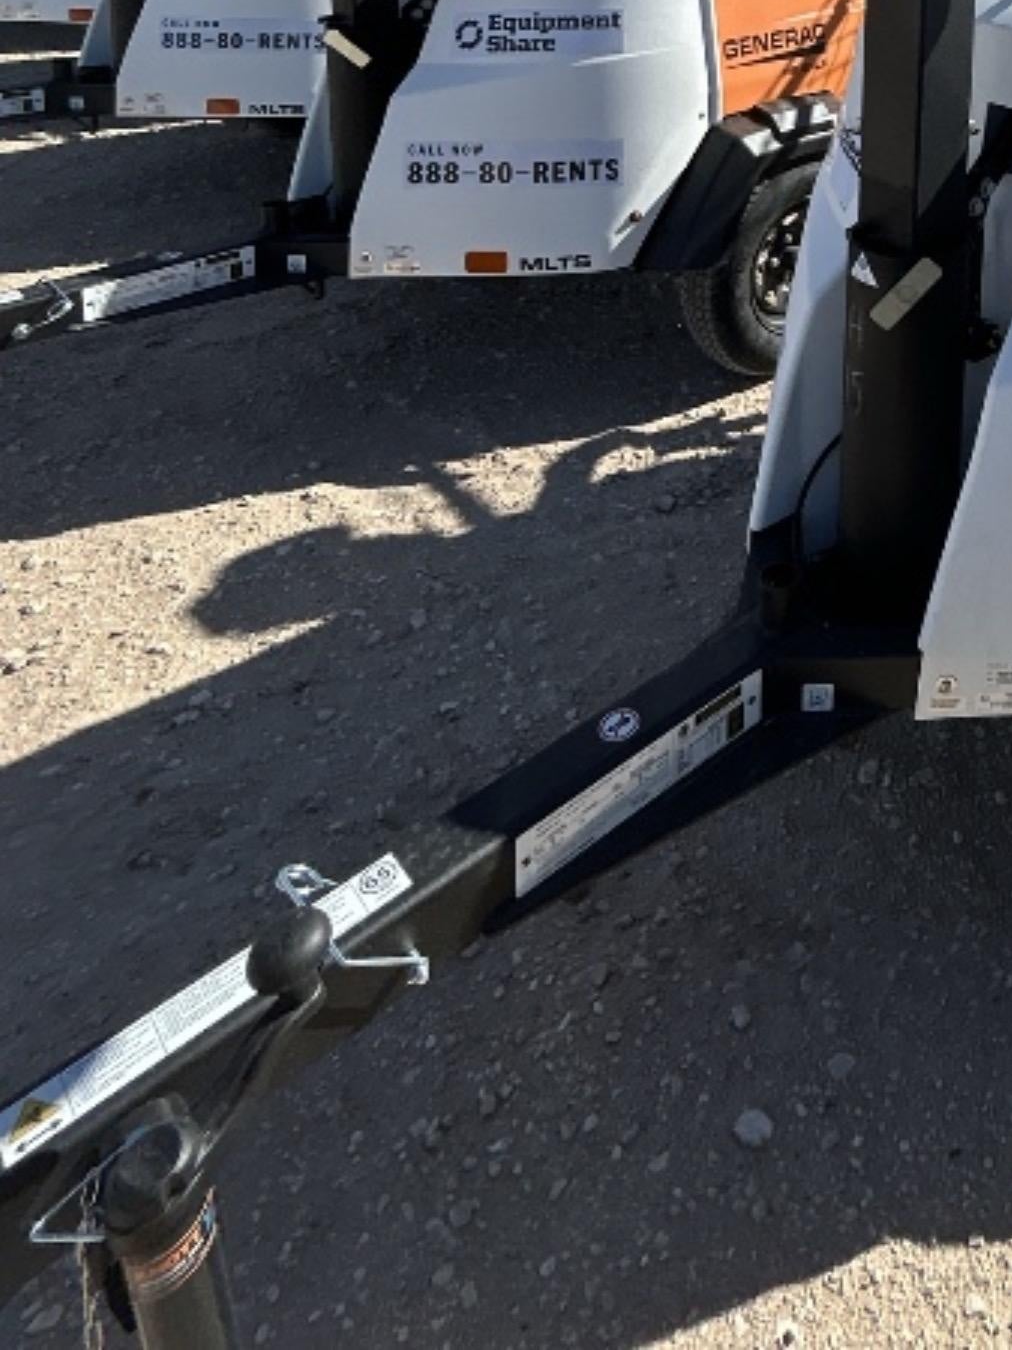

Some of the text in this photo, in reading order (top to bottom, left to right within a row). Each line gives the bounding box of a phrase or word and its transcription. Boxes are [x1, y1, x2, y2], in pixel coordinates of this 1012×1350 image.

[486, 12, 622, 34] Equipment
[485, 35, 556, 52] Share
[722, 22, 826, 61] GENERAC
[407, 158, 620, 184] 888-80-RENTS
[519, 254, 592, 271] MLTS
